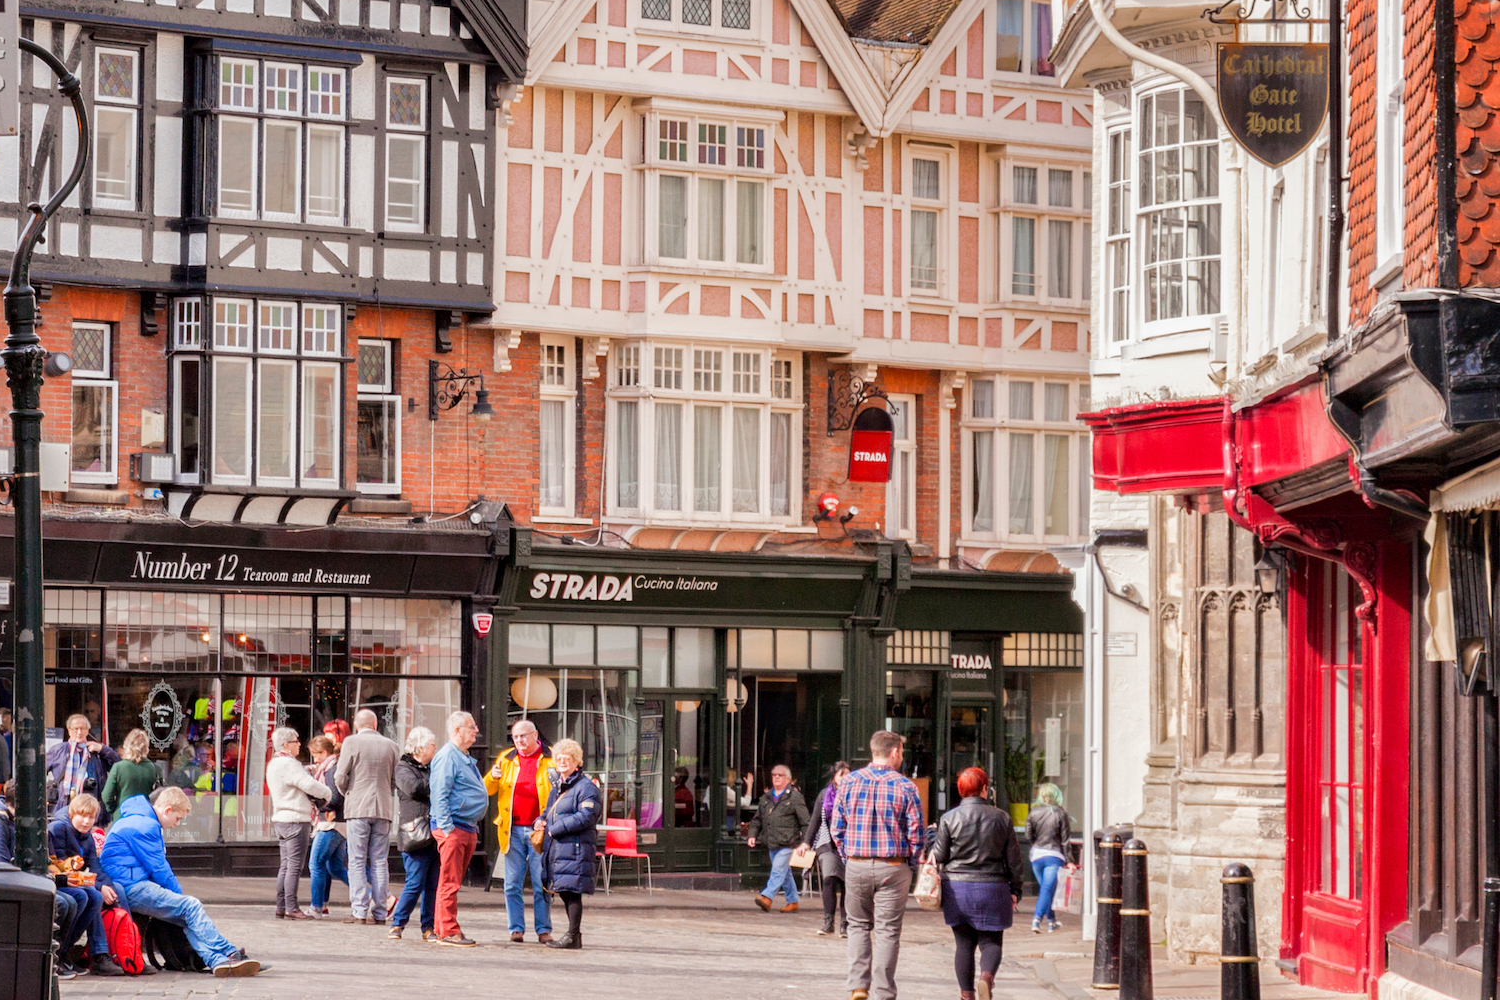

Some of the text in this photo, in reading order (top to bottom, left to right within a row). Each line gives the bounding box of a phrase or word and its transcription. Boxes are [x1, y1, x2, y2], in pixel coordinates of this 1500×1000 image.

[1223, 53, 1325, 78] Cathedral
[1249, 83, 1298, 105] Gate
[1245, 111, 1301, 137] Hotel
[854, 452, 887, 462] STRADA
[131, 551, 371, 585] Number 12 Tearoom and Restaurant
[529, 573, 719, 601] STRADA Cucina Italiana
[951, 654, 992, 669] TRADA
[166, 829, 200, 838] Restaurant
